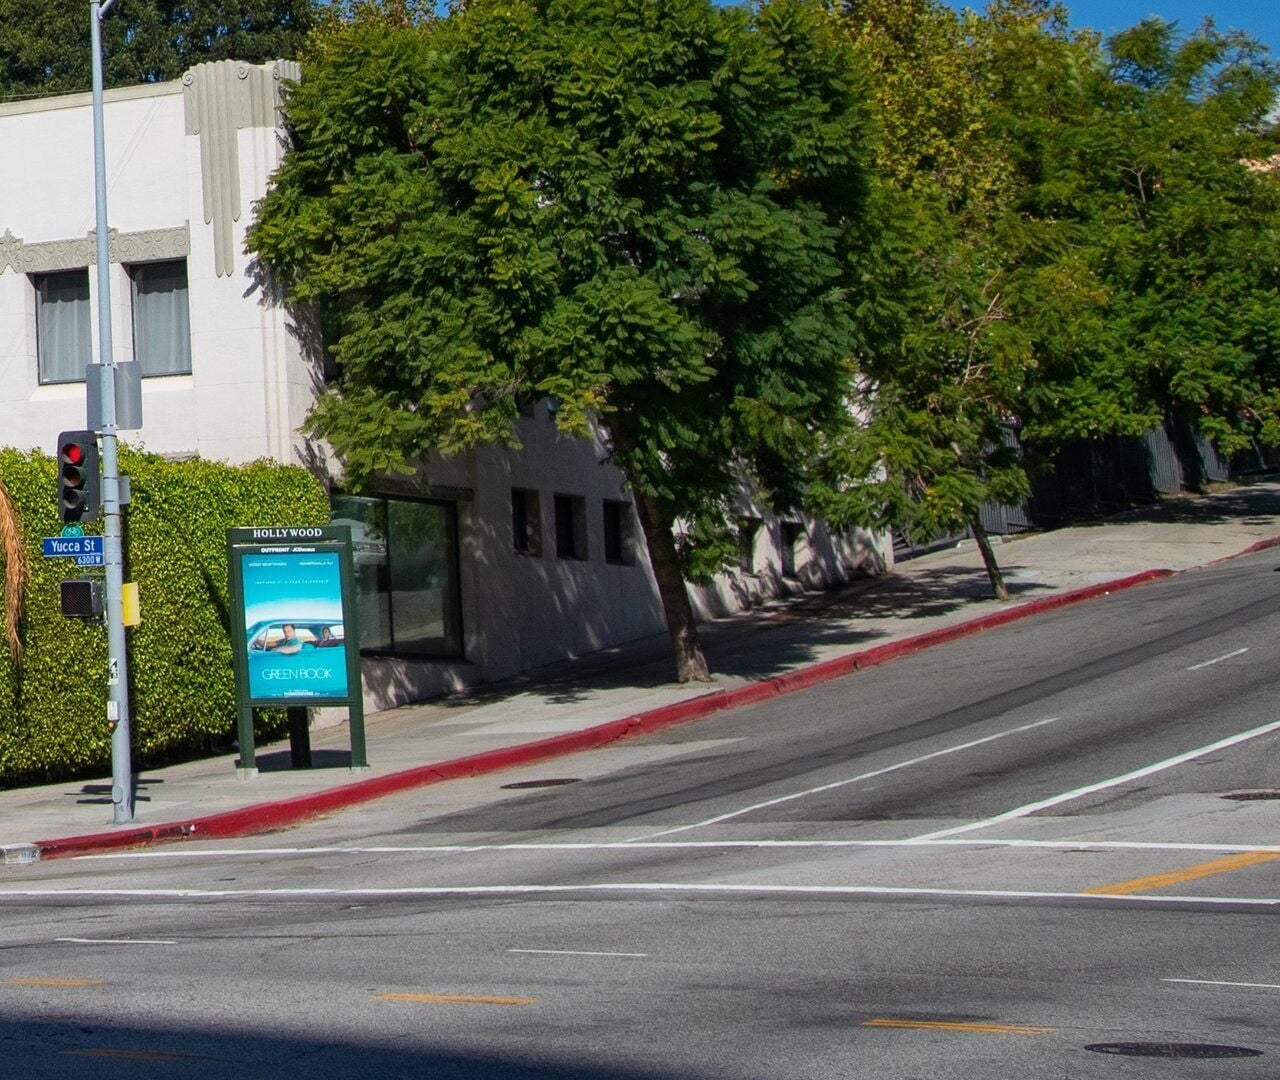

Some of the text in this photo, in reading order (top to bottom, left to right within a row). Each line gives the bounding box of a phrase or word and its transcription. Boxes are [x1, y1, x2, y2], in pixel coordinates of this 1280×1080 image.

[253, 528, 323, 538] HOLLYWOOD
[51, 539, 96, 552] Yucca St
[77, 555, 101, 564] 6300 W
[261, 667, 333, 680] GREEN BOOK
